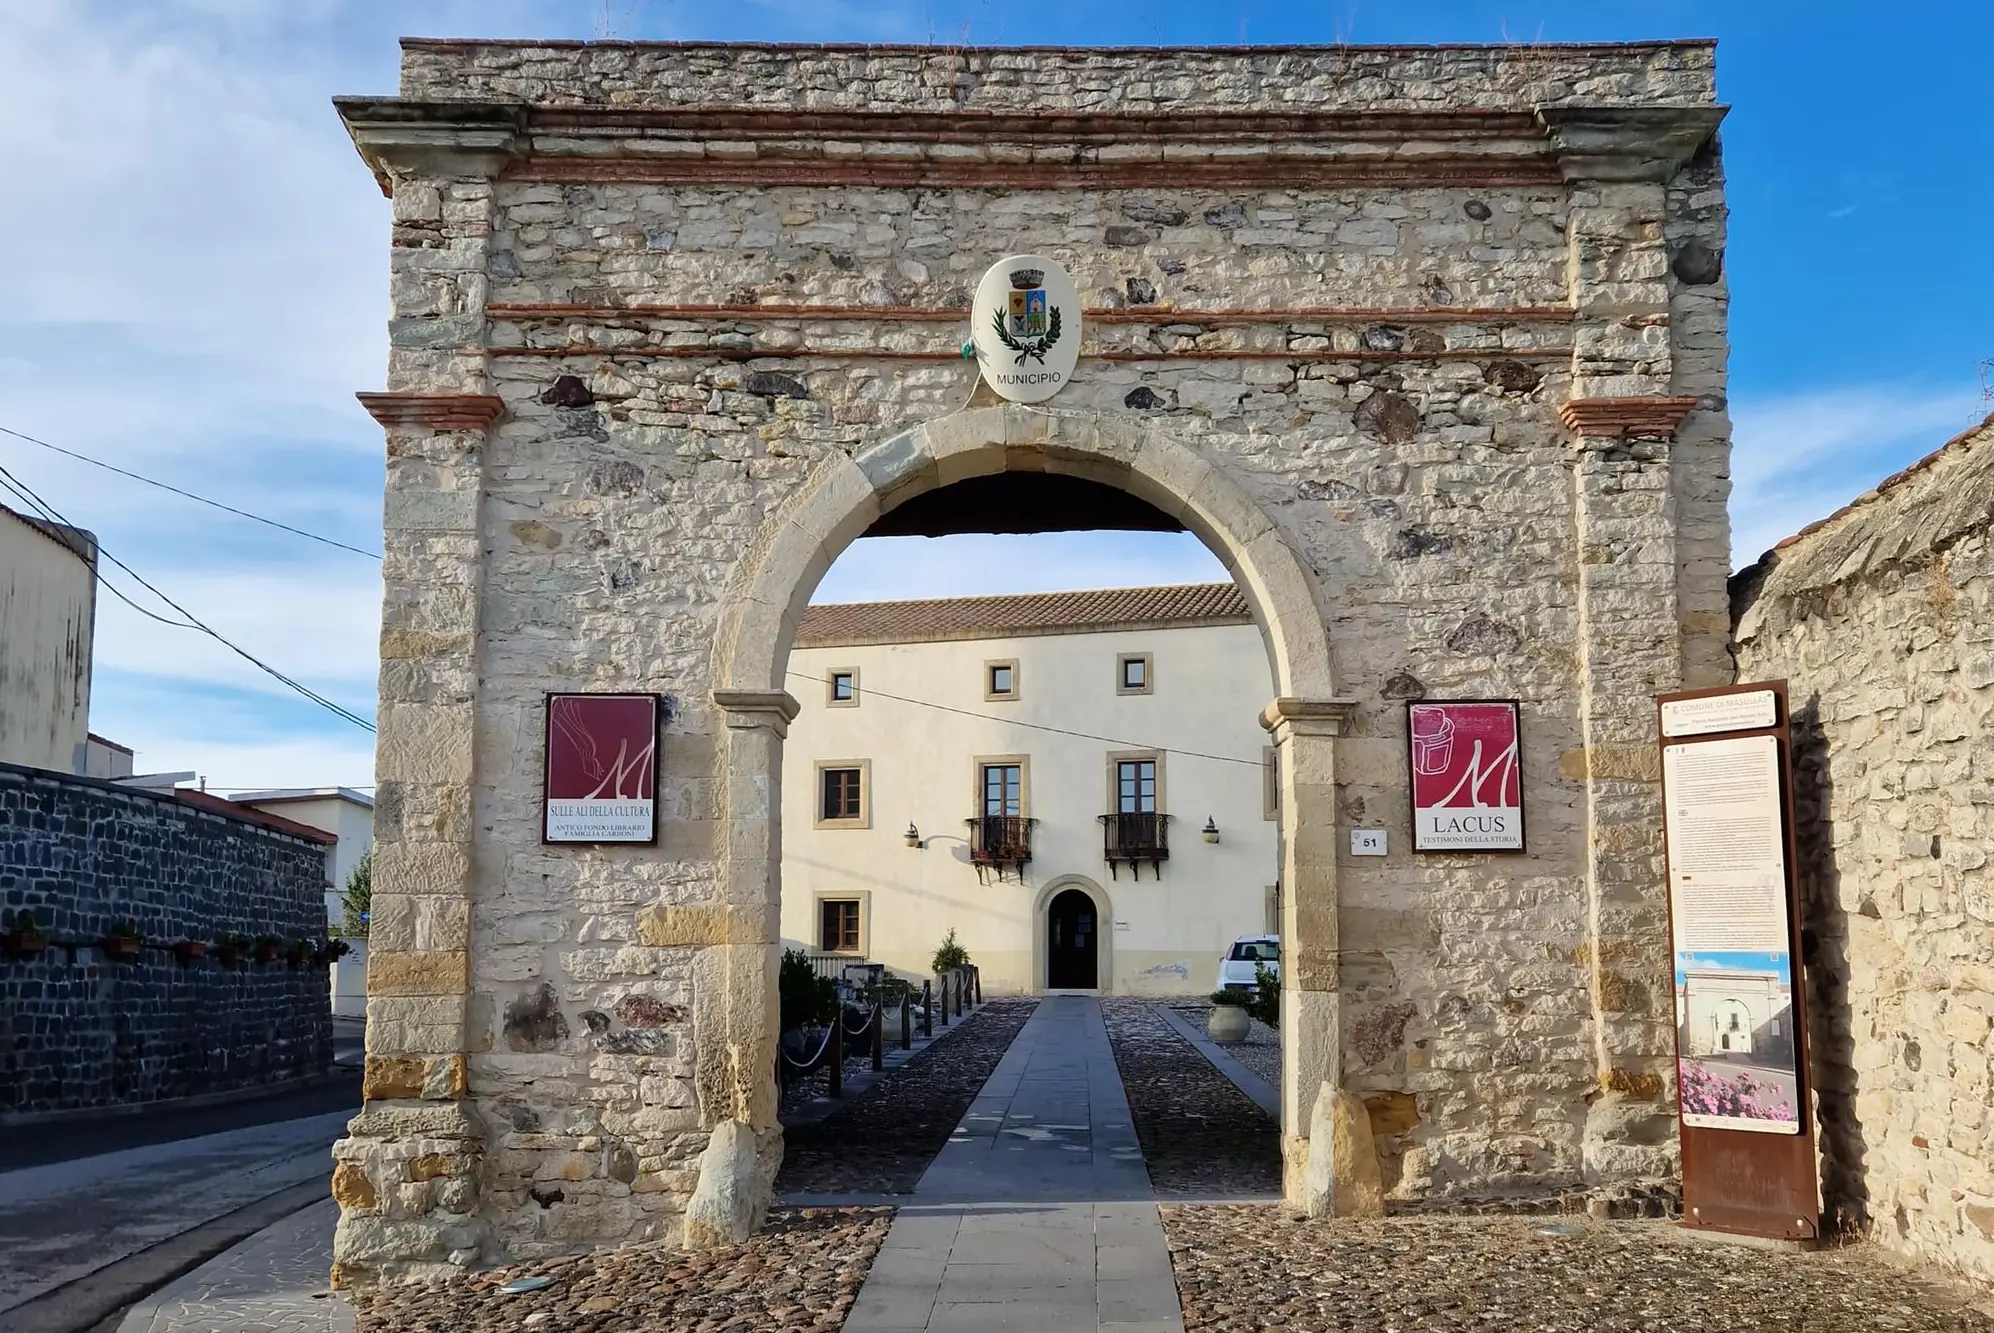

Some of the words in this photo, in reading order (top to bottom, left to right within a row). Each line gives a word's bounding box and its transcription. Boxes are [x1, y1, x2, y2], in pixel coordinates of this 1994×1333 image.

[996, 372, 1061, 385] MUNICIPIO
[1681, 701, 1717, 713] COMUNE
[1717, 700, 1725, 709] DI
[1726, 696, 1768, 707] MASULLAS
[550, 805, 573, 817] SULLE
[576, 805, 588, 817] ALI
[589, 805, 614, 817] DELLA
[615, 805, 650, 817] CULTURA
[1433, 816, 1506, 833] LACUS
